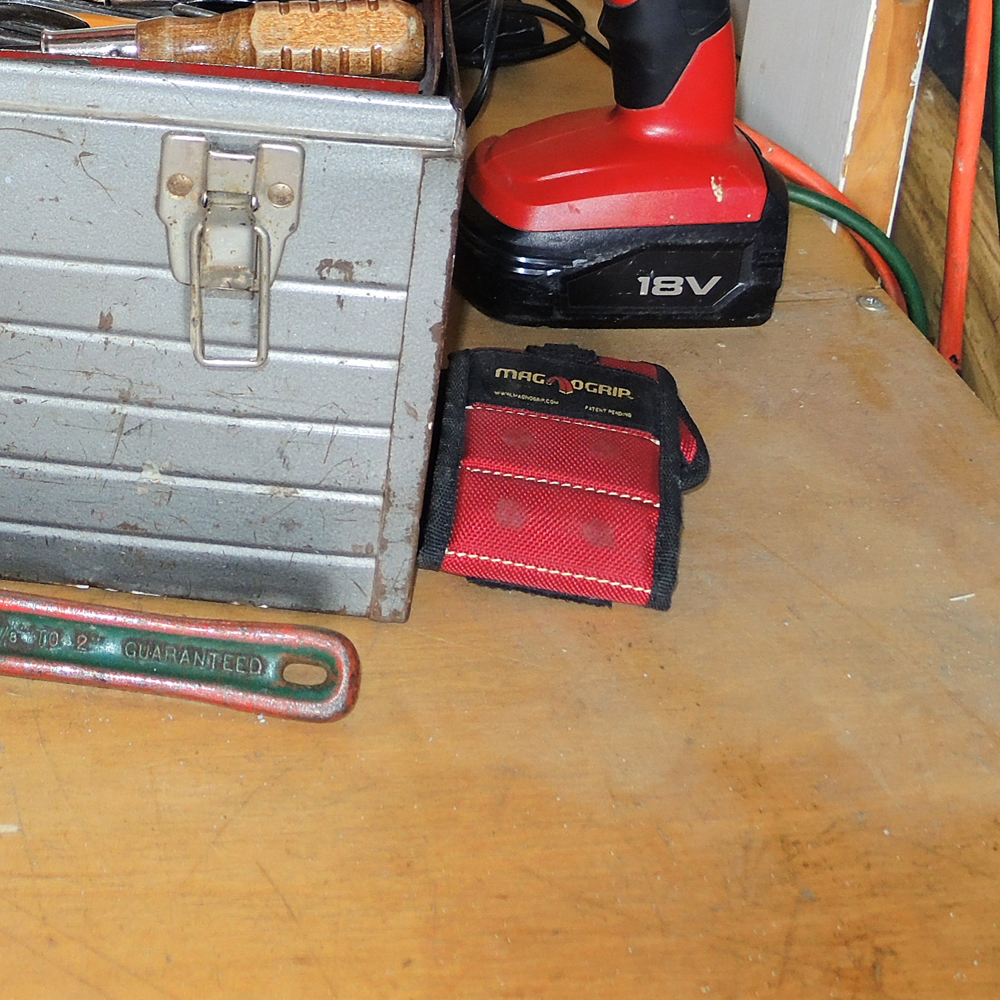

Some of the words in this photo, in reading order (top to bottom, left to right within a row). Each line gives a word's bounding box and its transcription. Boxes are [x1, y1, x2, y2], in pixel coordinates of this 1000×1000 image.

[637, 275, 722, 296] 18V
[38, 628, 59, 648] TO
[124, 640, 263, 675] GUARANTEED
